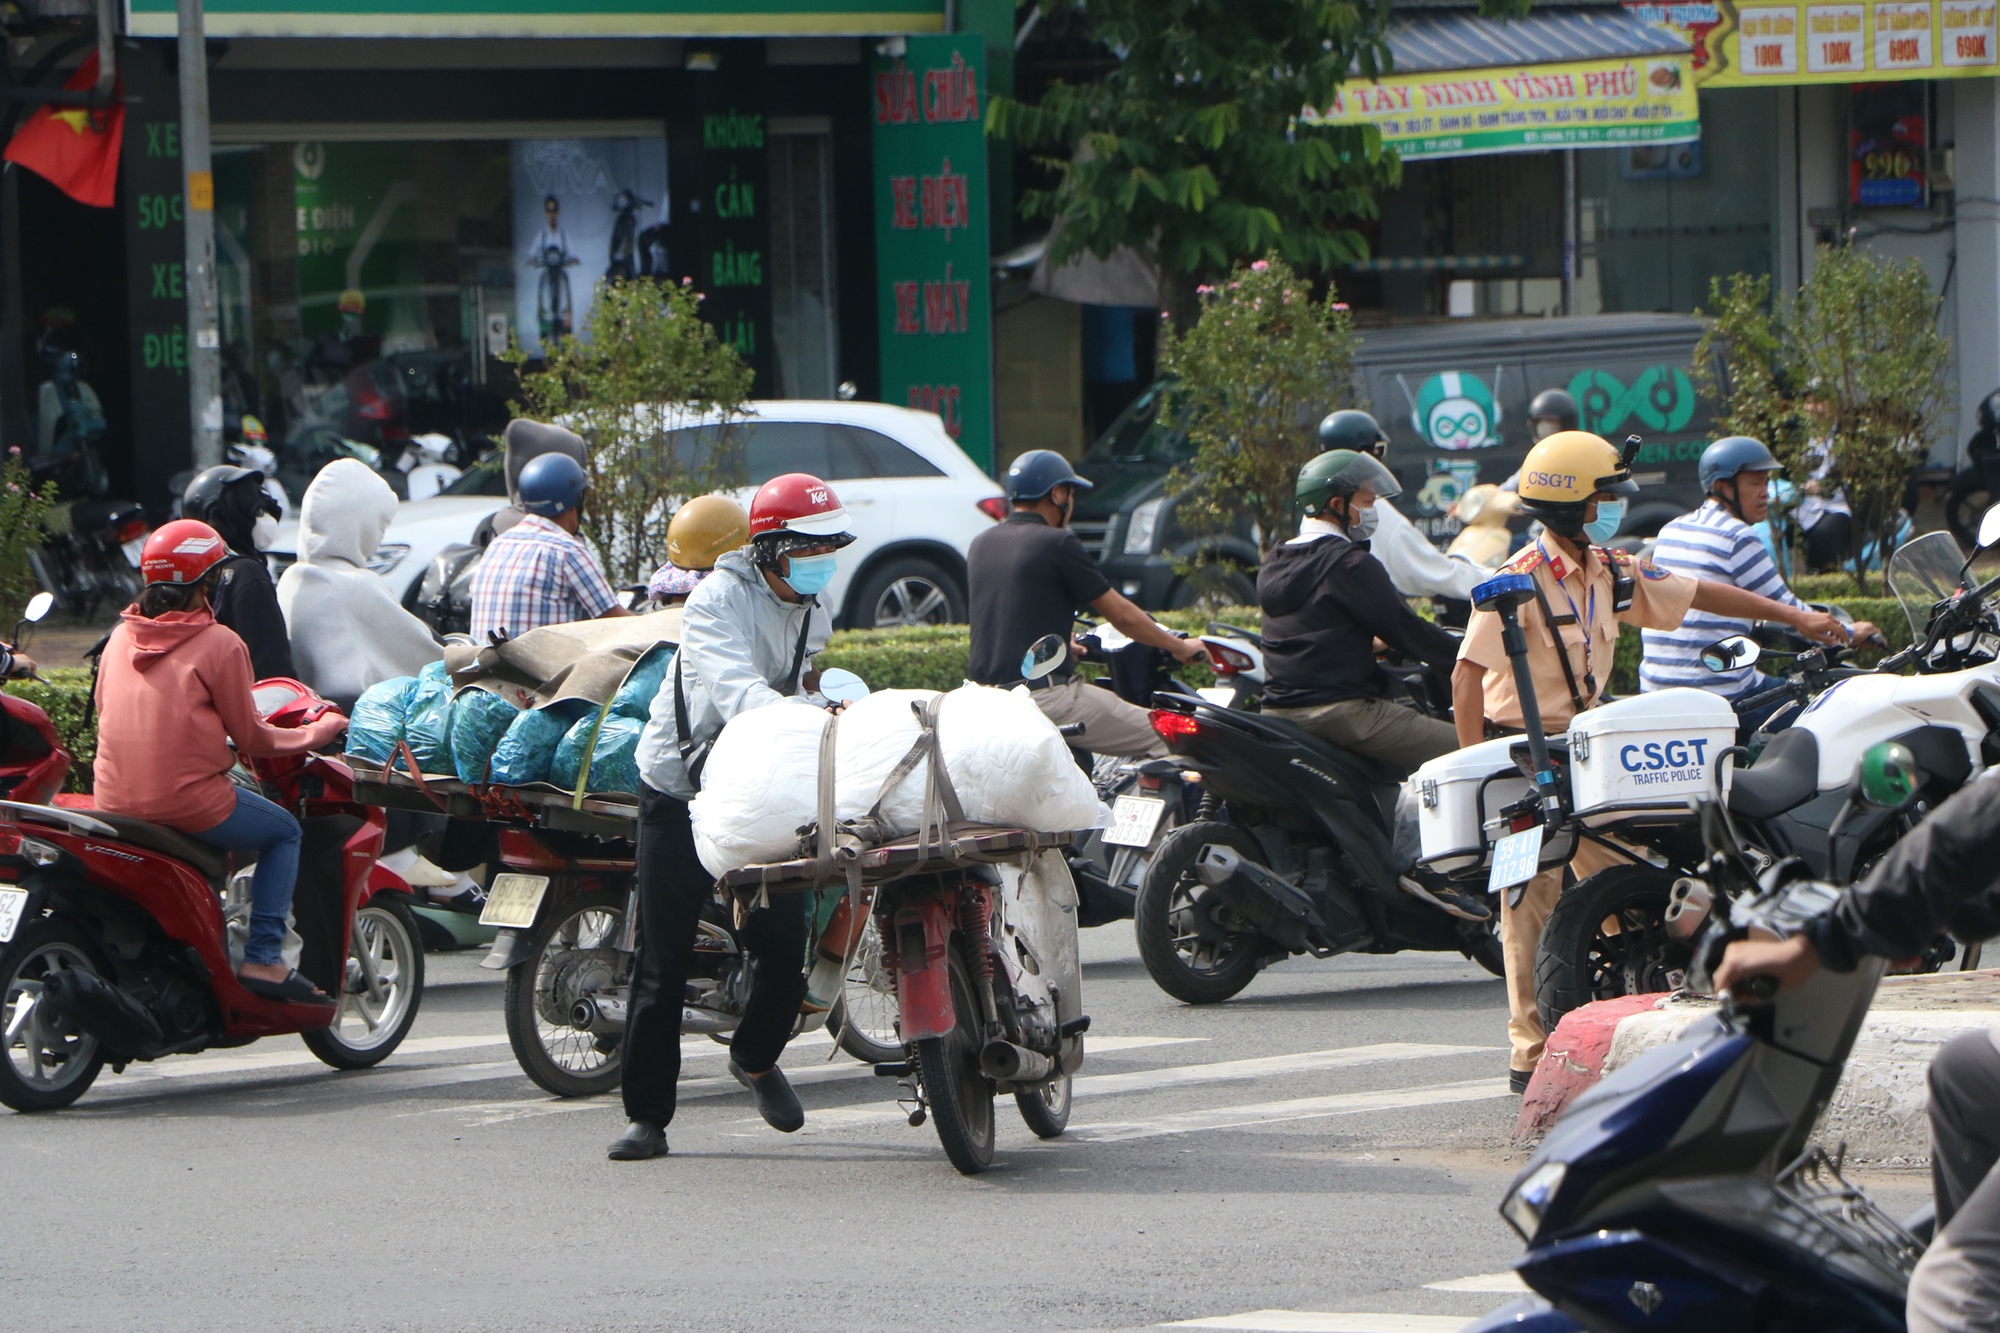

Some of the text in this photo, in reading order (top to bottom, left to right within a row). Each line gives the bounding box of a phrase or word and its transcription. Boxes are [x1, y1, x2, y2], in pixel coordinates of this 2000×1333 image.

[1754, 44, 1783, 67] 100K
[1821, 41, 1852, 66] 100K
[1889, 38, 1919, 62] 690K
[1956, 35, 1987, 59] 690K
[923, 50, 979, 124] CHỮA
[1352, 82, 1412, 113] TÂY
[1420, 80, 1499, 108] NINH
[1502, 71, 1576, 99] VĨNH
[1583, 62, 1637, 98] PHÚ
[147, 122, 180, 157] XE
[704, 108, 765, 148] KHÔNG
[526, 161, 620, 195] VIVA
[891, 157, 969, 243] XE ĐIỆN
[152, 263, 184, 299] XE
[894, 262, 970, 335] XE MÁY
[1528, 471, 1577, 489] CSGT
[1620, 738, 1708, 772] C.S.G.T
[1632, 768, 1703, 786] TRAFFIC POLICE
[84, 842, 145, 863] VISION
[1500, 831, 1535, 862] 59-A1
[1492, 854, 1535, 888] 012.96
